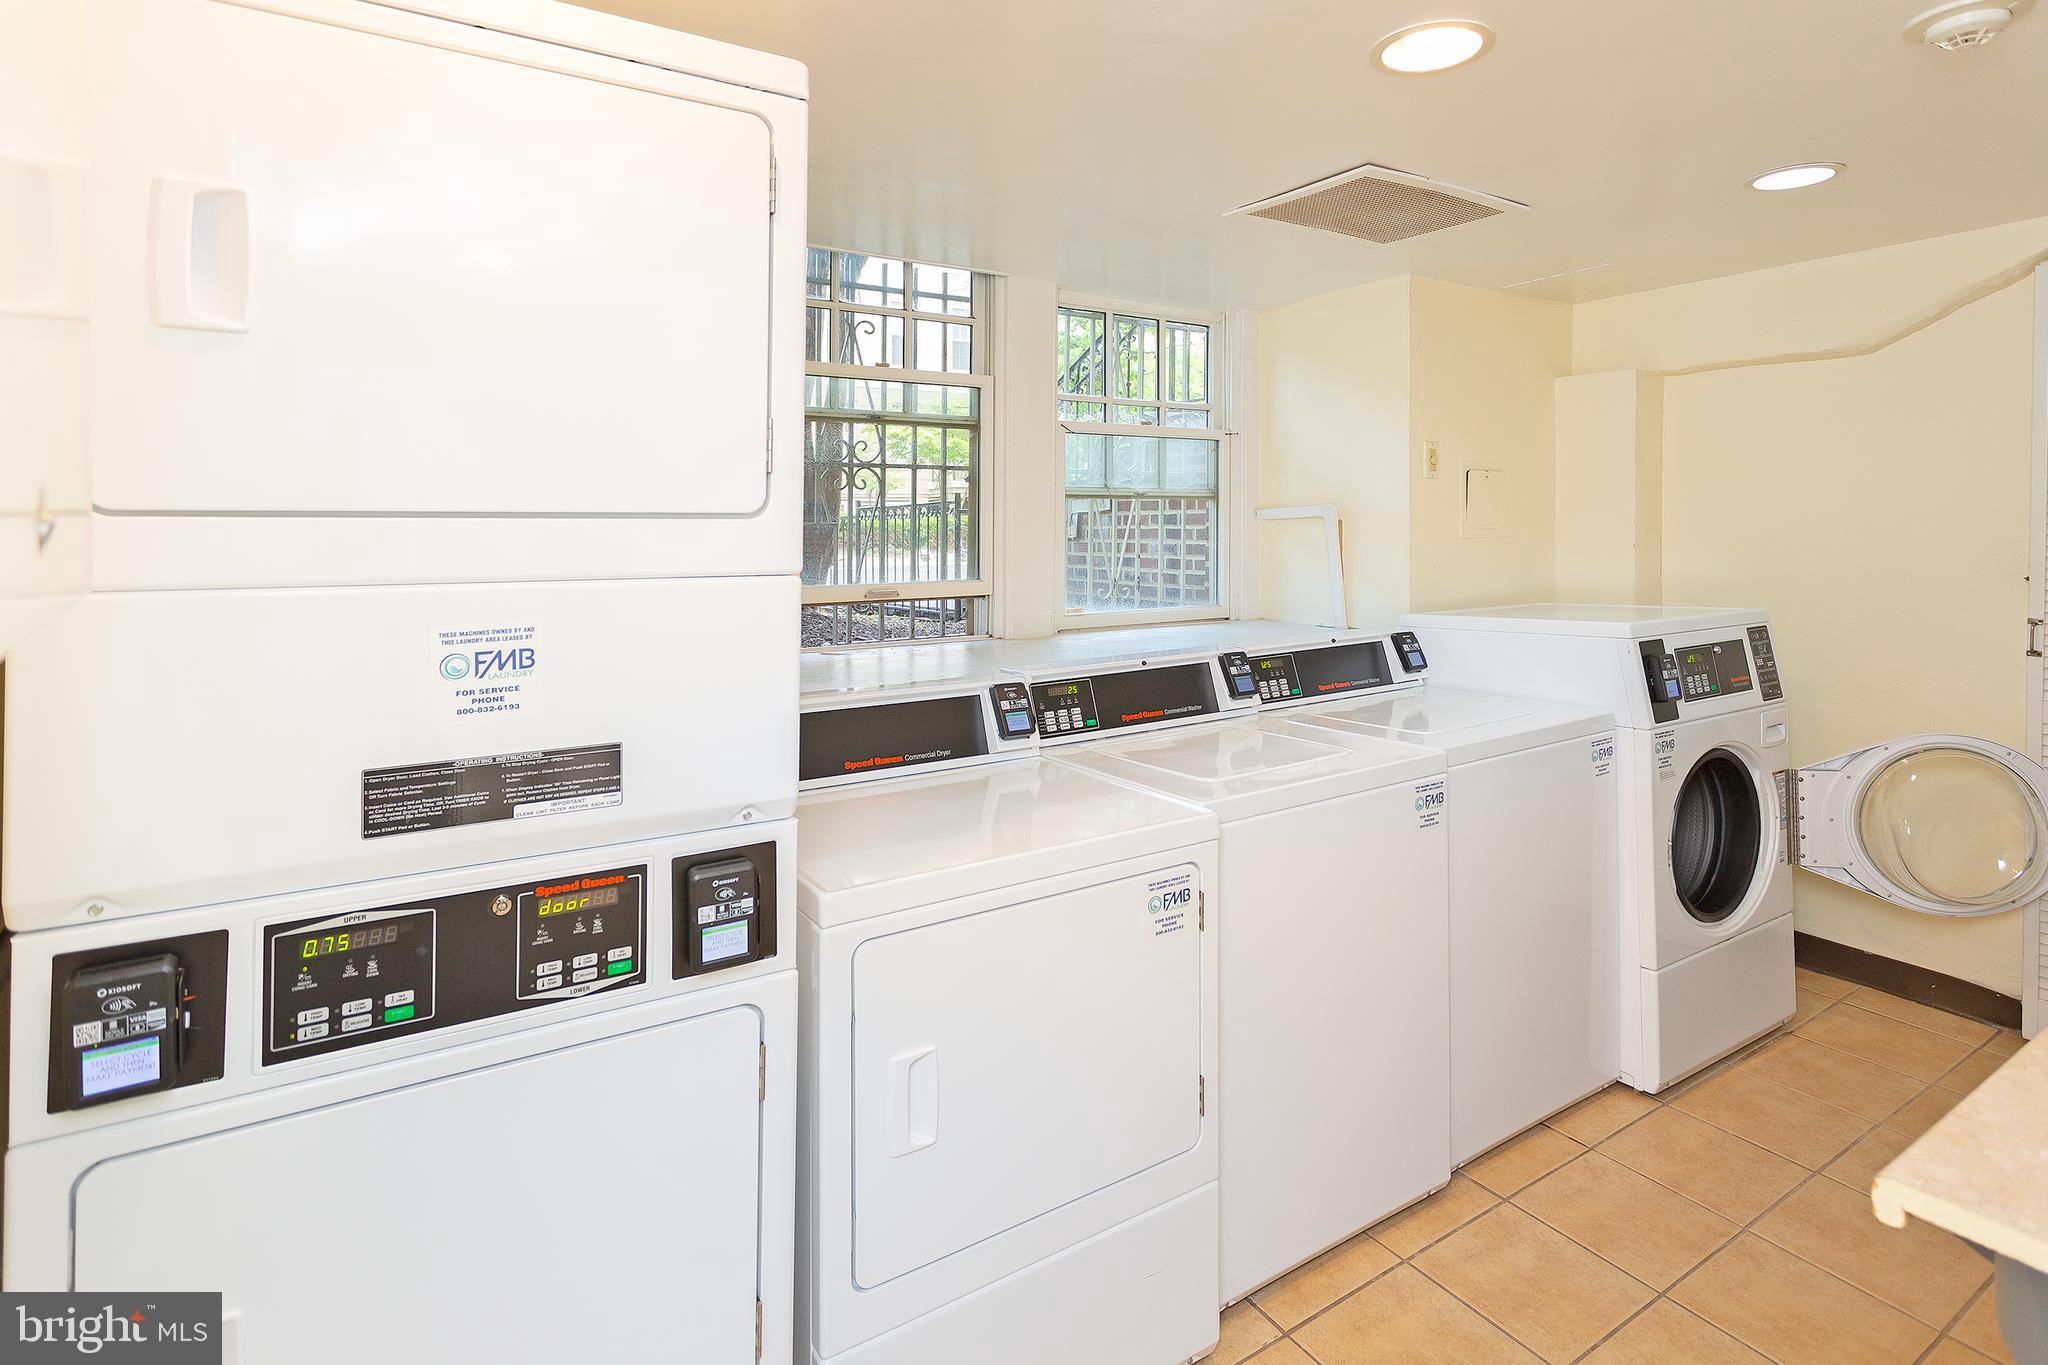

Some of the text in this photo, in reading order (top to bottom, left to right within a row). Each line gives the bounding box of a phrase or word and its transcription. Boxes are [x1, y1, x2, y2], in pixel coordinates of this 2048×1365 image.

[474, 648, 535, 679] FMB
[488, 670, 533, 680] LAUNDRY
[456, 685, 520, 697] FOR SERVICE
[472, 696, 505, 704] PHONE
[456, 703, 519, 715] 800-832-6193
[1121, 712, 1142, 722] Speed
[1143, 709, 1164, 718] Queen
[1164, 706, 1187, 715] Commercial
[844, 749, 952, 770] Speed Queen Commercial Dryer
[1425, 792, 1444, 809] FMB
[535, 875, 625, 897] Speed Queen
[538, 898, 589, 916] door
[1163, 888, 1191, 911] FMB
[343, 914, 367, 924] UPPER
[302, 933, 350, 958] 0.75
[570, 986, 590, 994] LOWER
